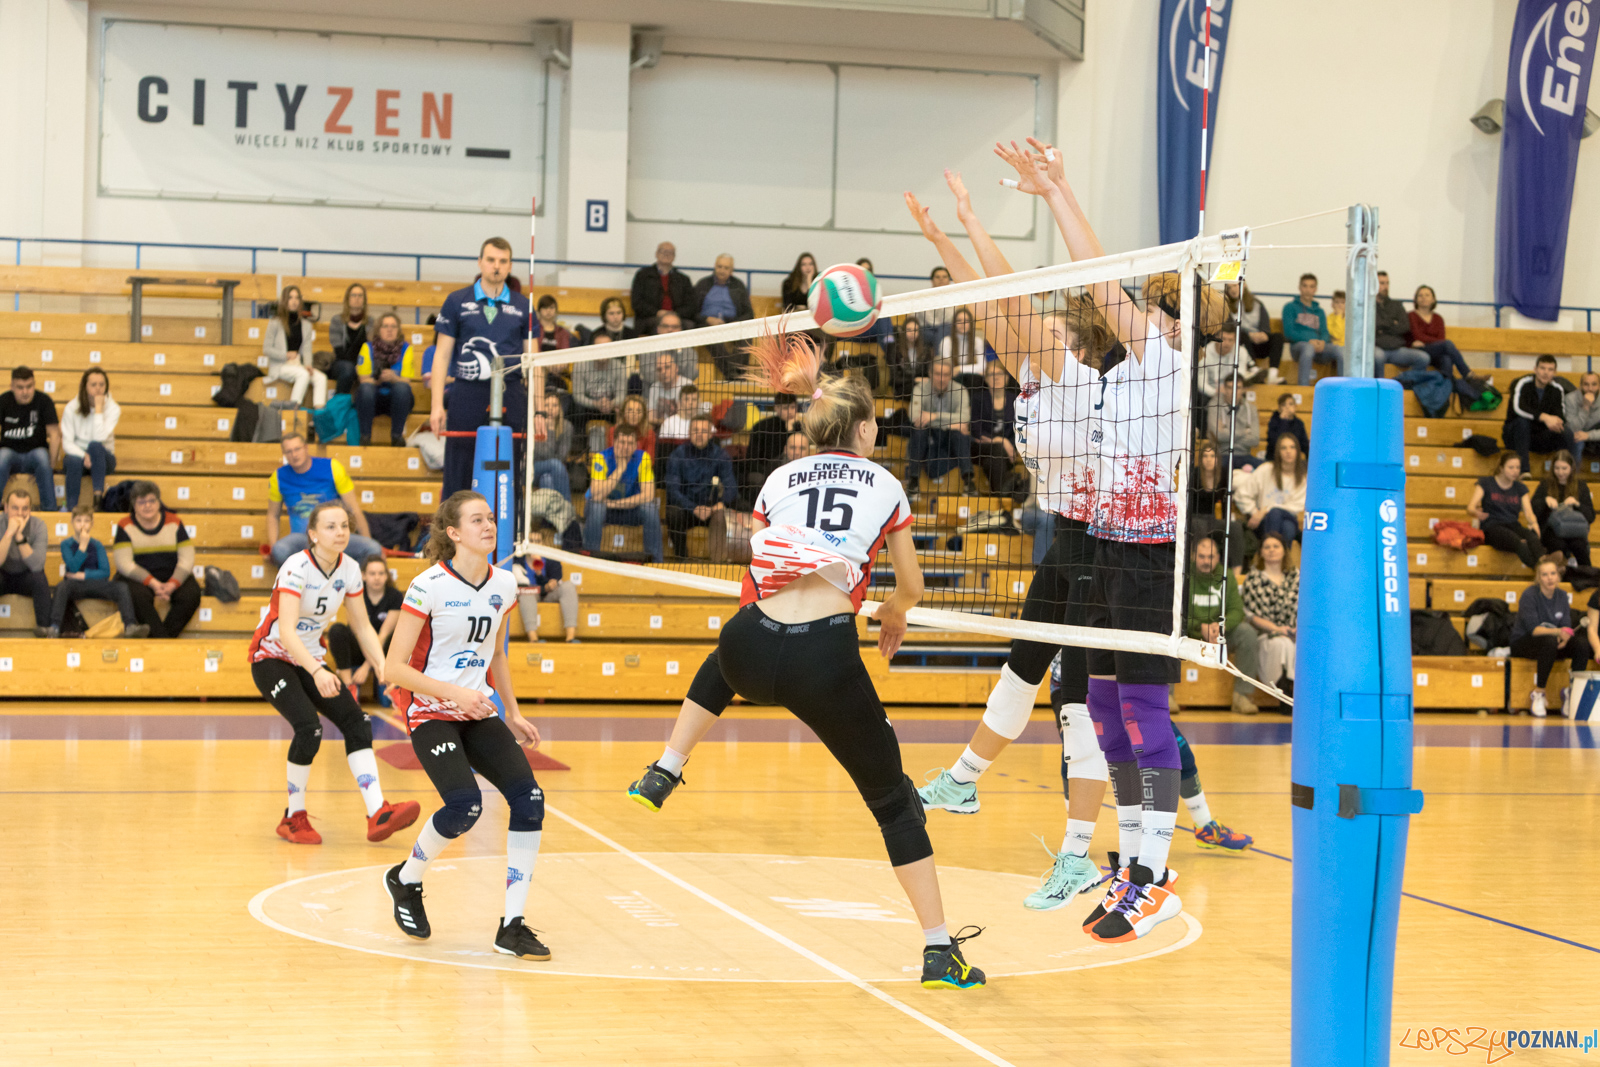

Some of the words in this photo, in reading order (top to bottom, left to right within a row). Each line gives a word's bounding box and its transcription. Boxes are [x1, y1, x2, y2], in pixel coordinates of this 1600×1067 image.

[1540, 0, 1593, 116] Ene
[137, 75, 453, 140] CITYZEN
[235, 134, 287, 148] WIĘCEJ
[328, 139, 364, 151] KLUB
[372, 141, 453, 156] SPORTOWY
[589, 204, 605, 228] B
[814, 463, 850, 471] ENEA
[788, 469, 875, 489] ENERGETYK
[799, 487, 859, 532] 15
[313, 596, 328, 616] 5
[467, 616, 492, 643] 10
[786, 624, 810, 634] NIKE
[271, 678, 287, 698] MS
[431, 742, 457, 756] WP
